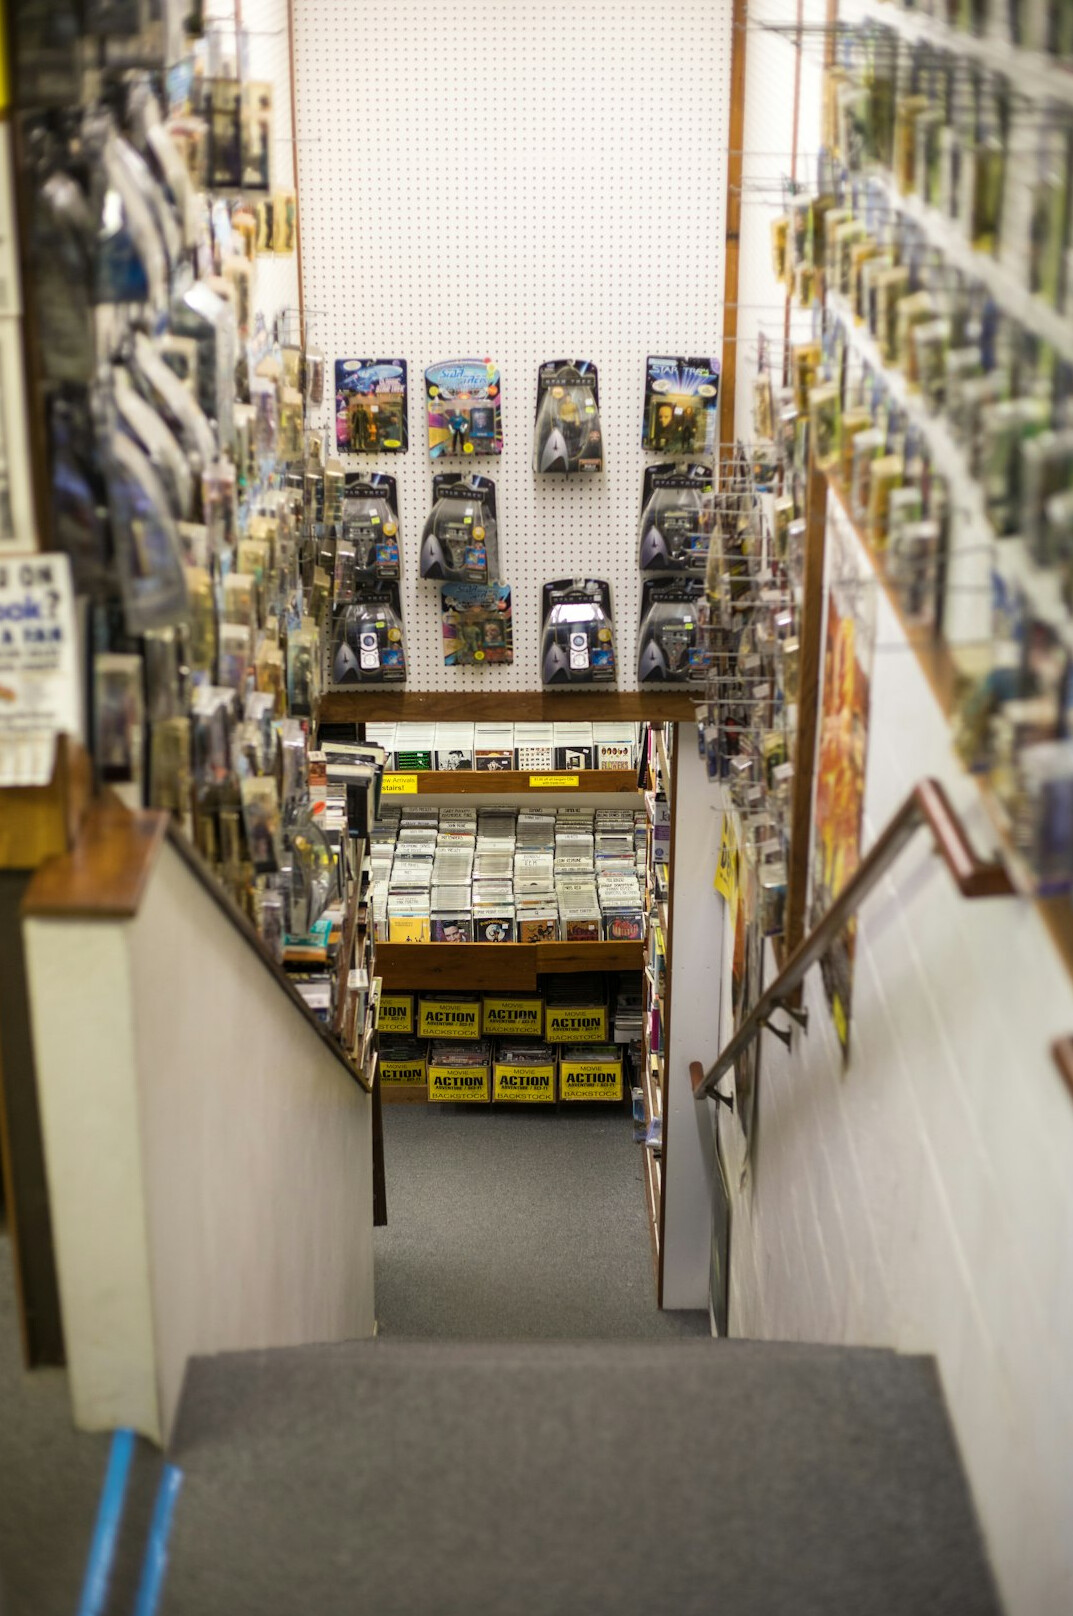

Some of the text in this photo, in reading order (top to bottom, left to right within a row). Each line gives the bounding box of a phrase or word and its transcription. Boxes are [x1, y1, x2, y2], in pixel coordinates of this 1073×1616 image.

[649, 366, 678, 374] STAR
[380, 1007, 407, 1016] TION
[488, 1010, 537, 1019] ACTION
[426, 1012, 475, 1022] ACTION
[551, 1018, 600, 1027] ACTION
[434, 1076, 483, 1085] ACTION
[500, 1076, 549, 1085] ACTION
[567, 1073, 616, 1083] ACTION
